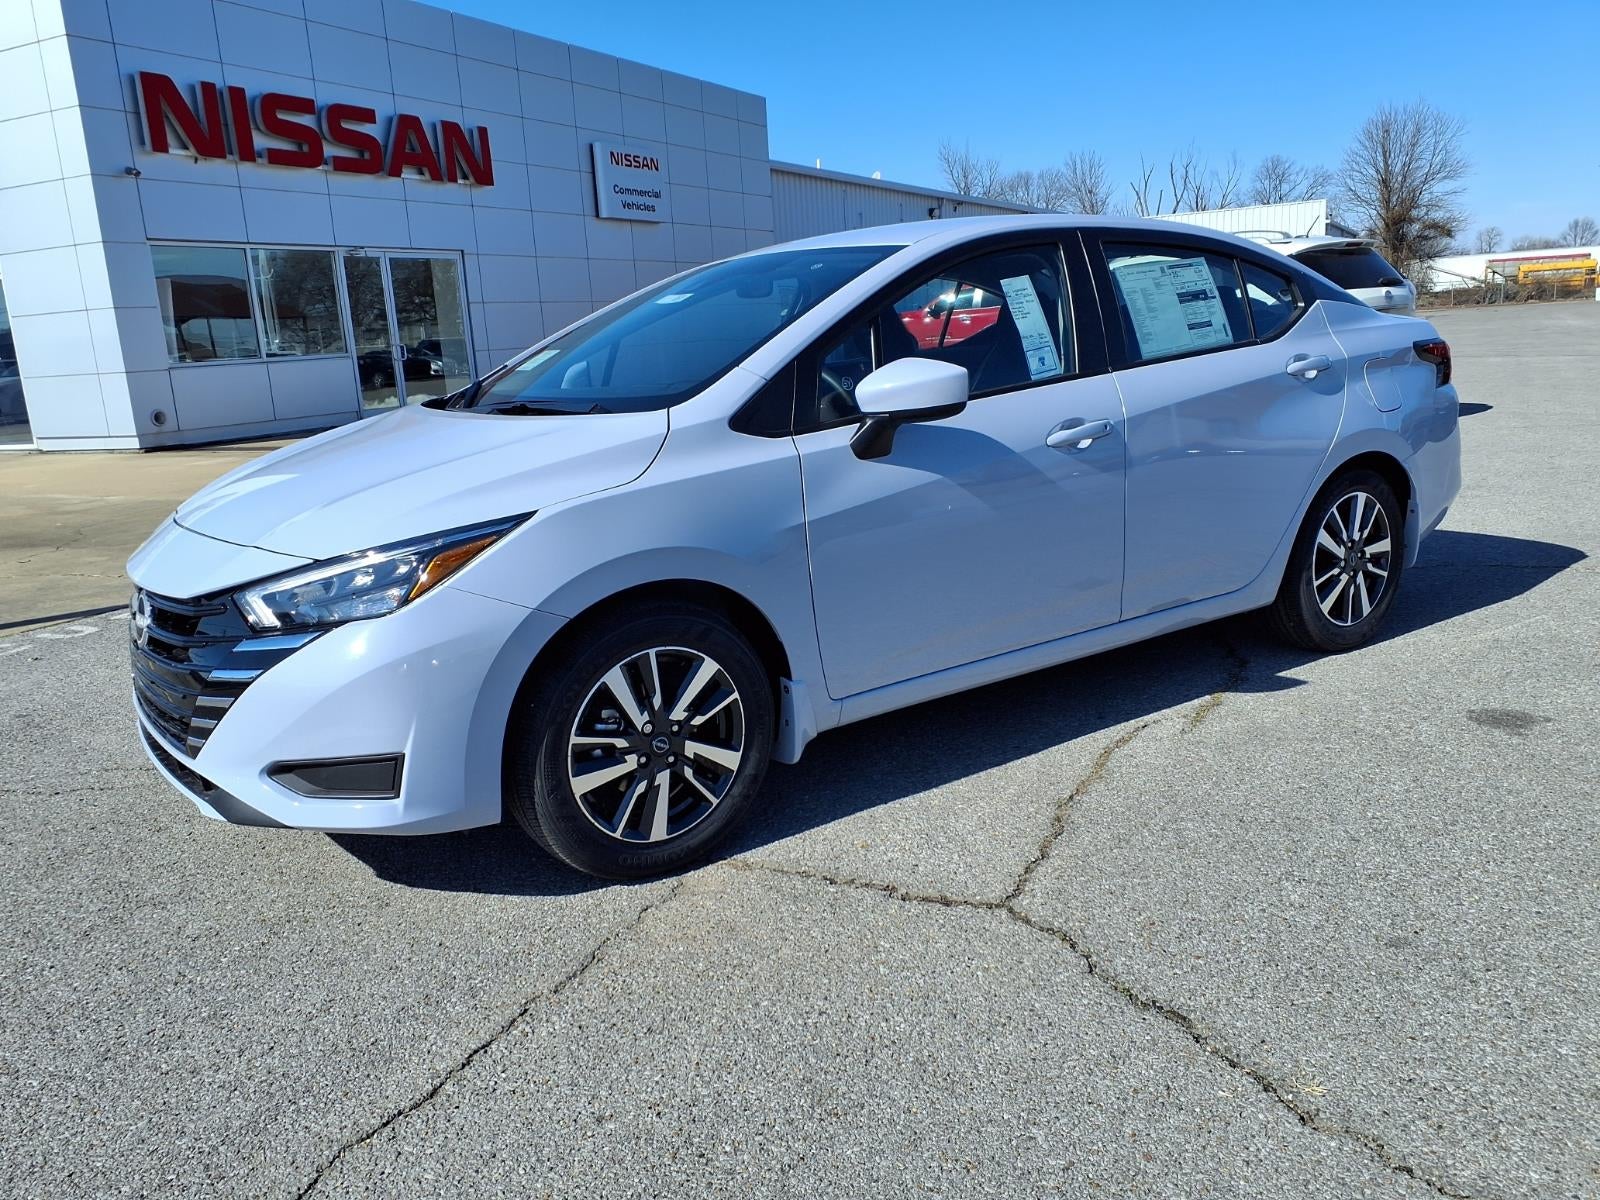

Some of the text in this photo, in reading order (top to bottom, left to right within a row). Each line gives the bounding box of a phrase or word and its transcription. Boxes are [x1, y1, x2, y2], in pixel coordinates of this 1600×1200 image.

[139, 71, 494, 186] NISSAN
[609, 151, 659, 172] NISSAN
[613, 184, 662, 199] Commercial
[620, 200, 656, 213] Vehicles
